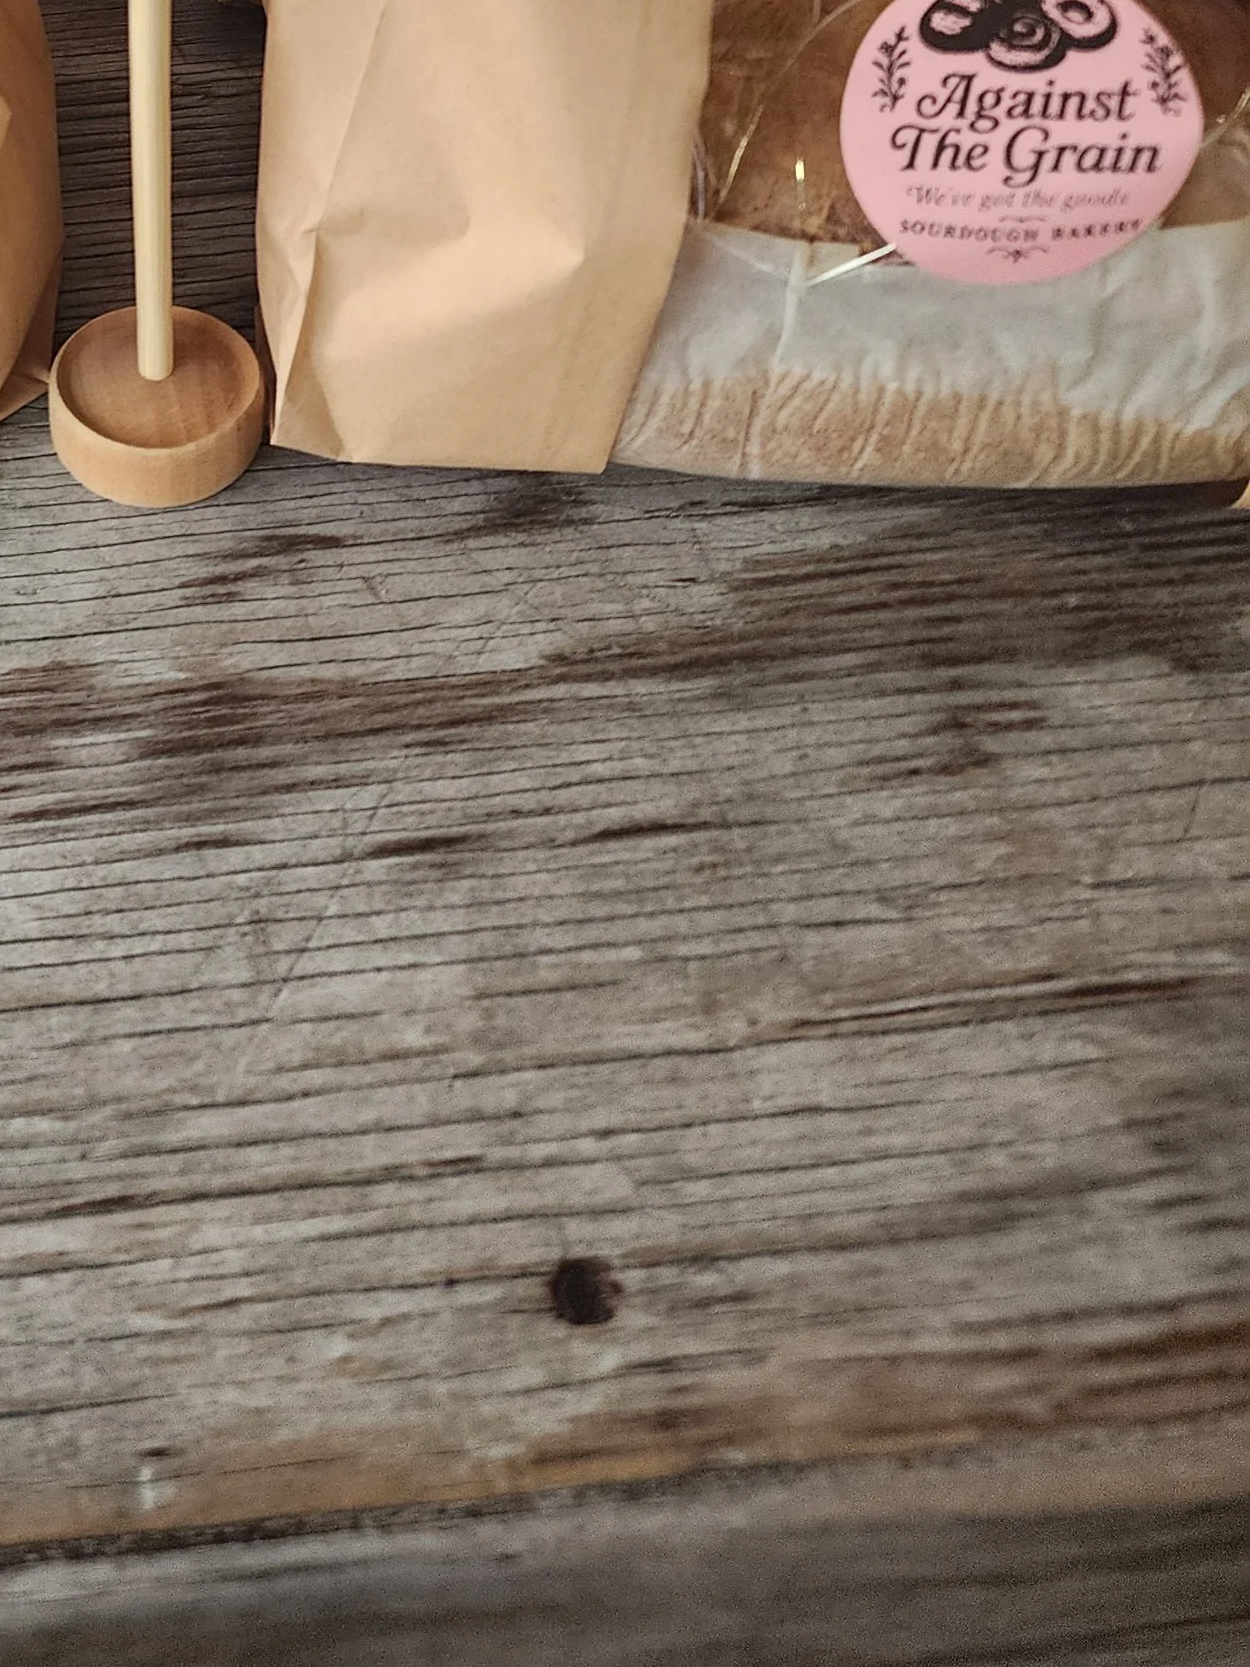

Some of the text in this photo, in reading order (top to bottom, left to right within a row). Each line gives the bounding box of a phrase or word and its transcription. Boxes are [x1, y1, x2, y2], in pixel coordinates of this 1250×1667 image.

[915, 71, 1141, 134] Against
[890, 124, 1162, 188] The Grain
[906, 185, 975, 206] We've
[978, 187, 1016, 212] got
[1021, 186, 1055, 206] the
[899, 218, 1039, 242] SOURDOUGH
